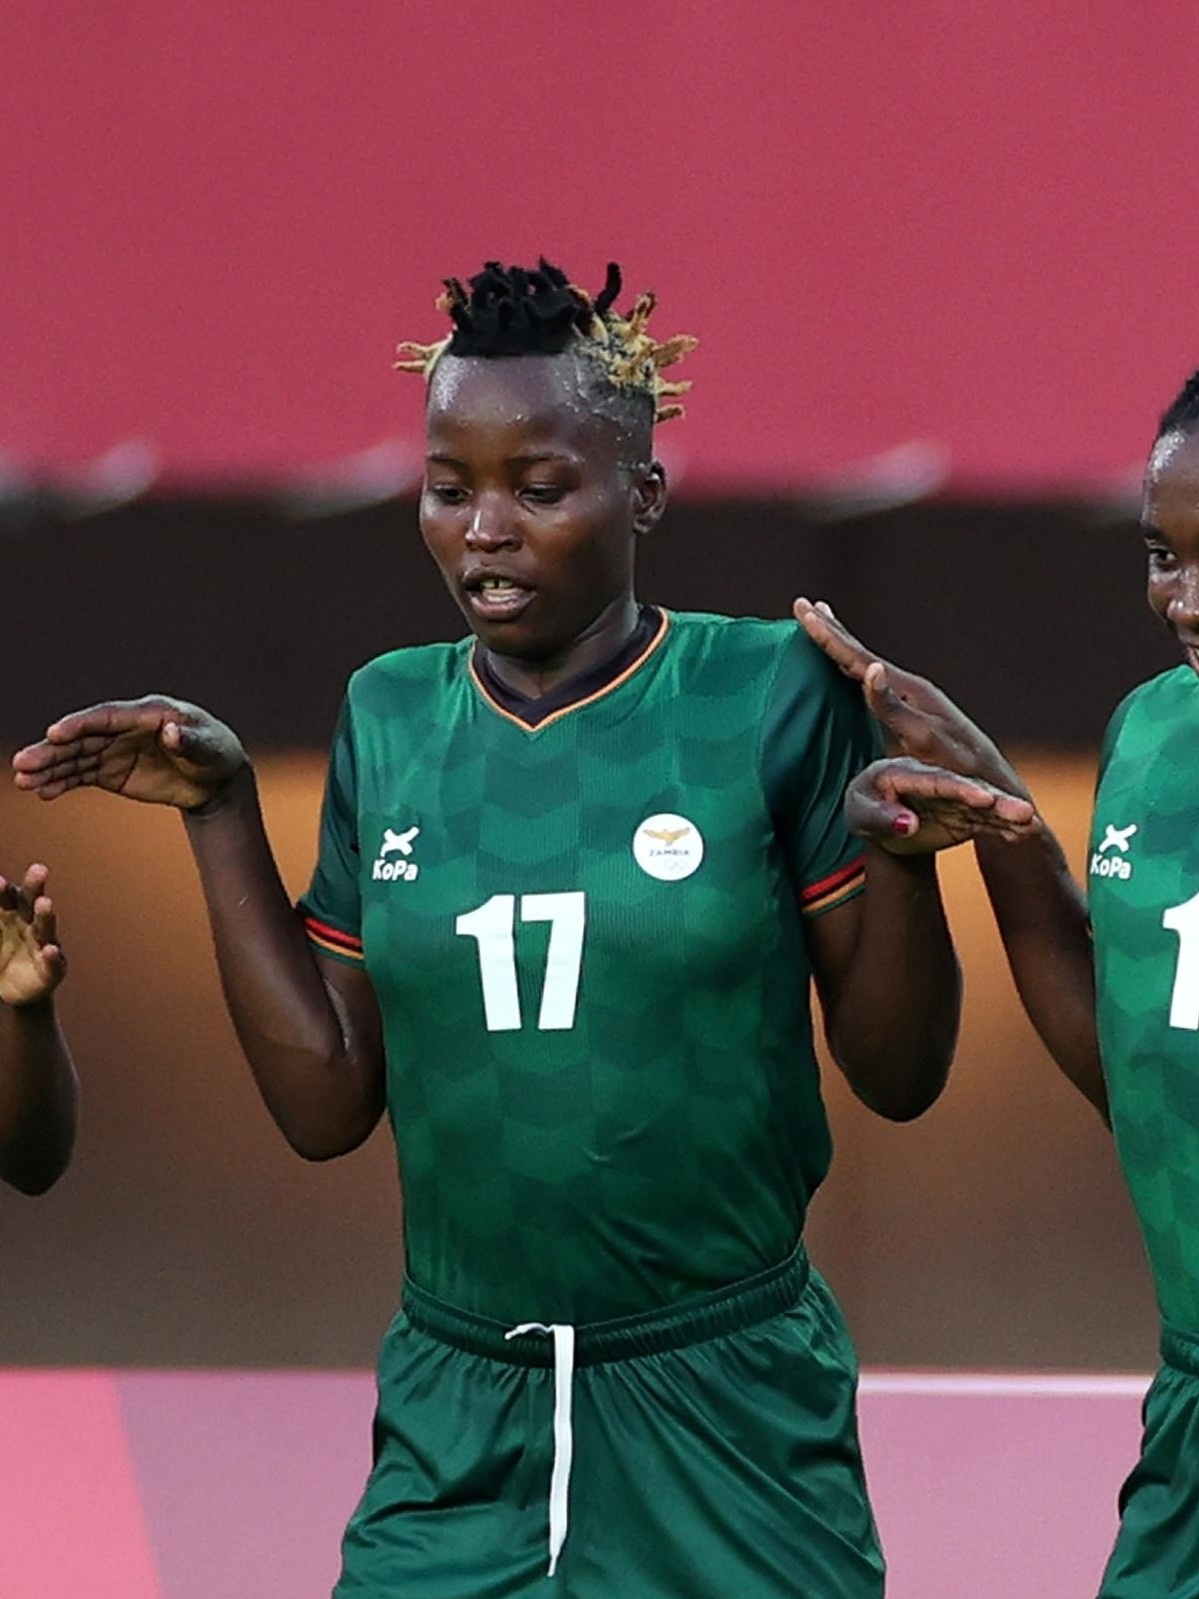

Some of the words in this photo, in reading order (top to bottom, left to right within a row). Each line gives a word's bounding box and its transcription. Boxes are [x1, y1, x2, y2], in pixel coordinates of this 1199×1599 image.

[372, 859, 418, 881] KoPa
[1090, 853, 1131, 880] KoPa
[455, 891, 586, 1031] 17
